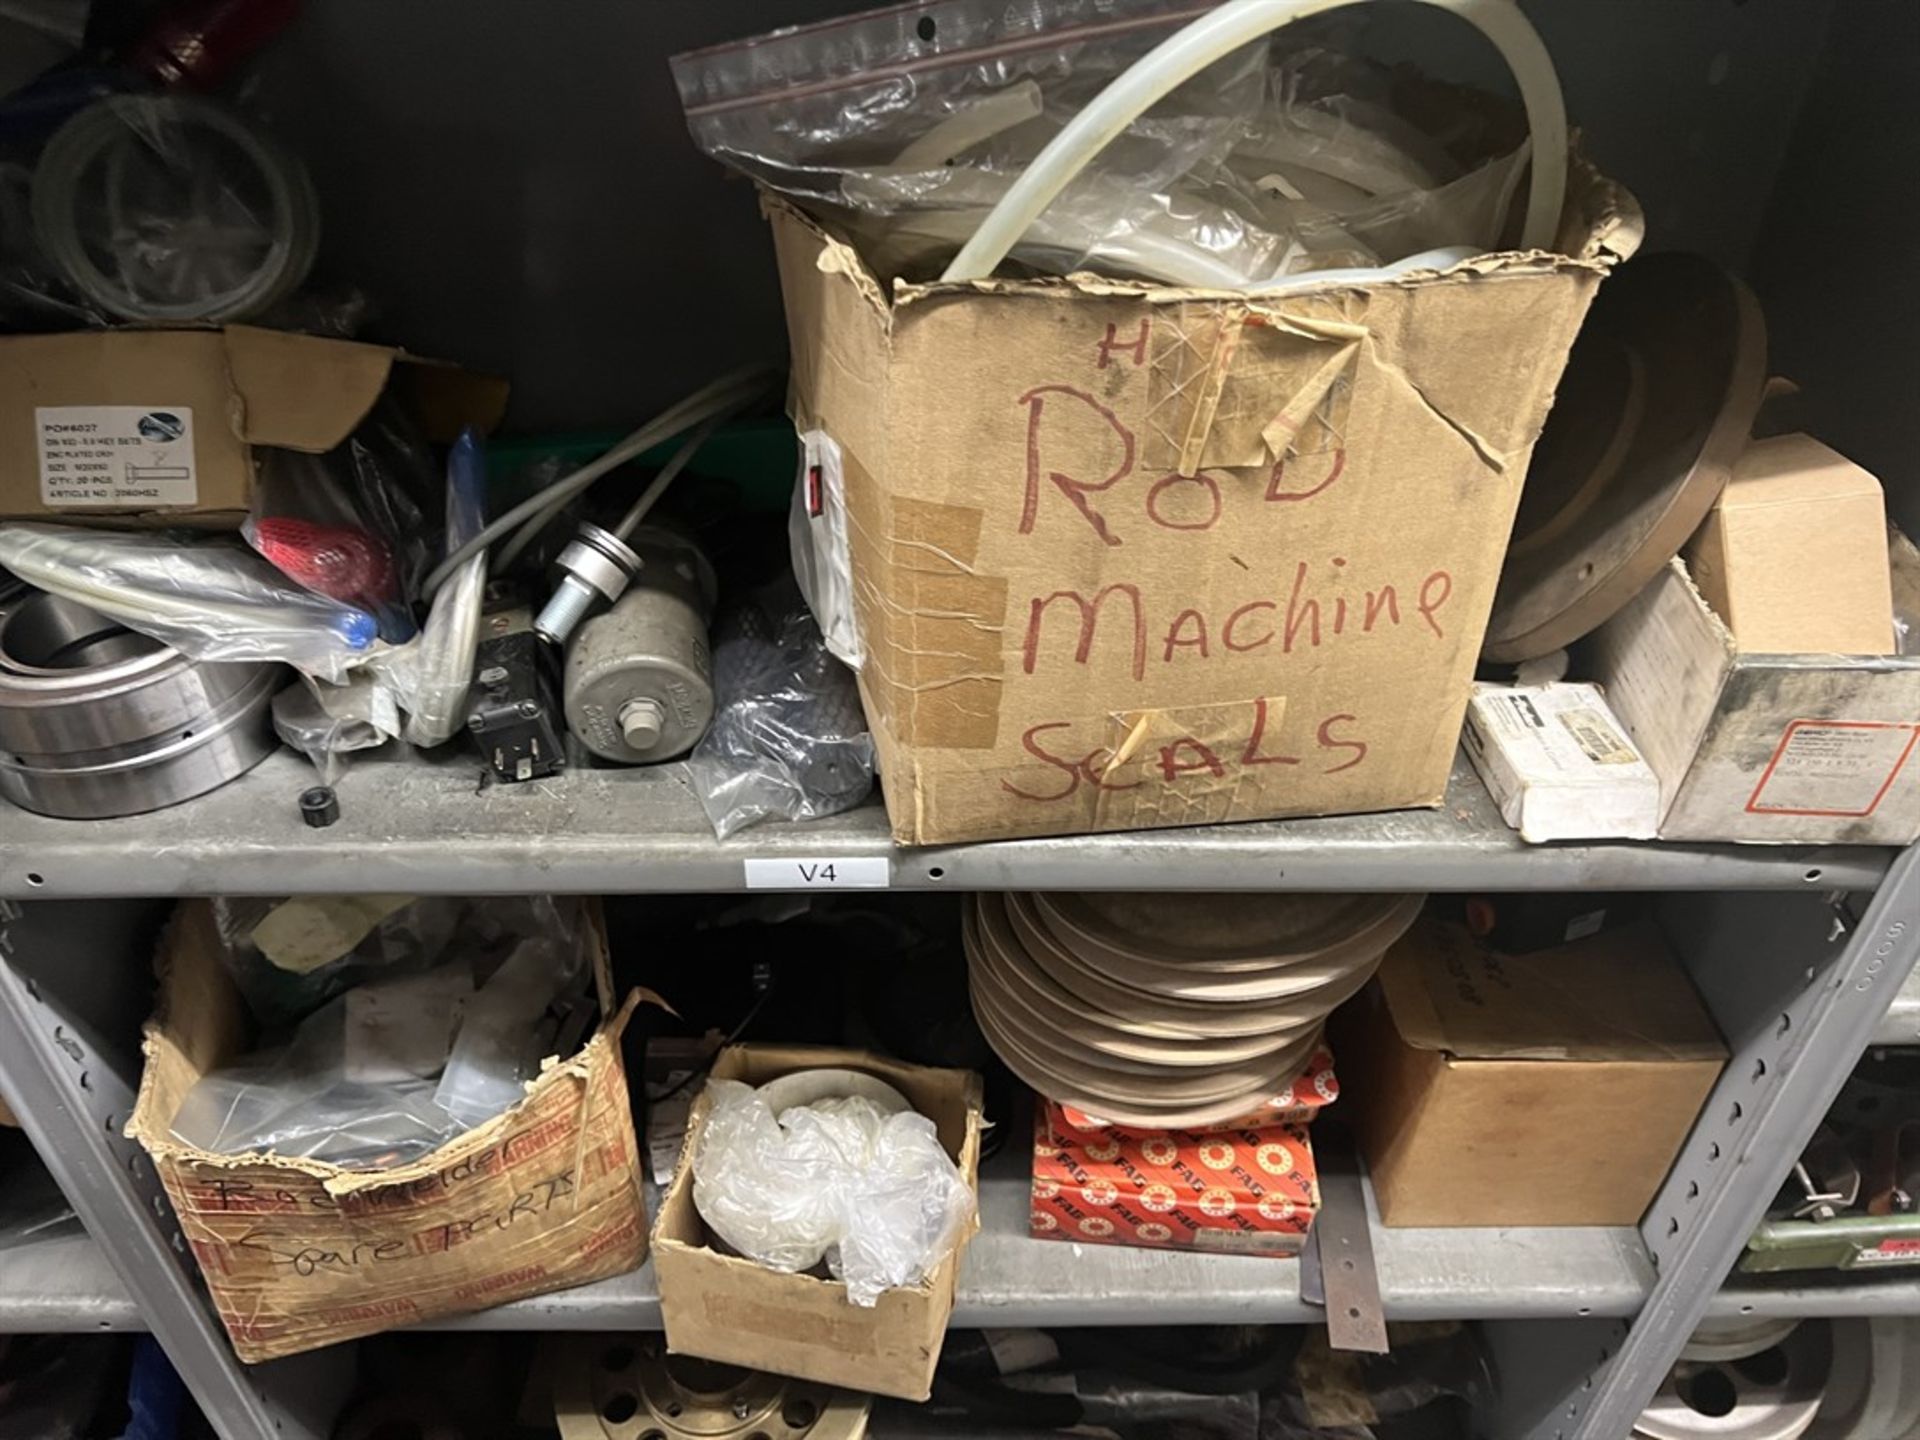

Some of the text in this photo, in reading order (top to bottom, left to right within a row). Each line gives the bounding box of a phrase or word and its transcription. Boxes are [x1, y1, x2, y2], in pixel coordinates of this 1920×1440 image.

[798, 863, 837, 883] V4
[1056, 1152, 1089, 1185] FAG
[1113, 1156, 1147, 1189] FAG
[1171, 1160, 1206, 1193] FAG
[1230, 1165, 1265, 1198] FAG
